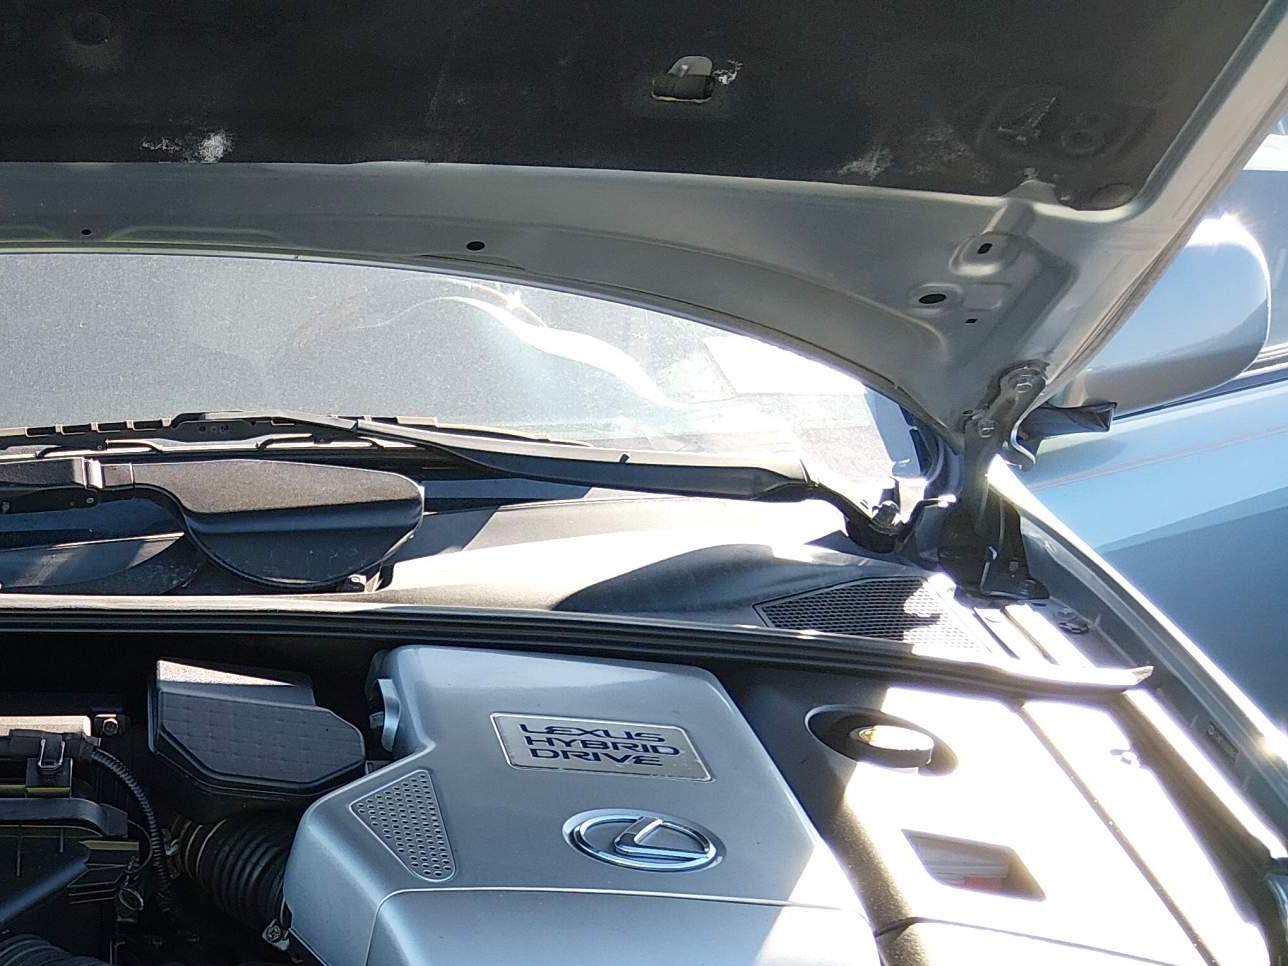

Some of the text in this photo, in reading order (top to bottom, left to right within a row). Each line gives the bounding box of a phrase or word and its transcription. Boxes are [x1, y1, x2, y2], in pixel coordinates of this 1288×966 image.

[519, 723, 665, 743] LEXUS
[524, 735, 680, 756] HYBRID
[530, 748, 663, 767] DRIVE
